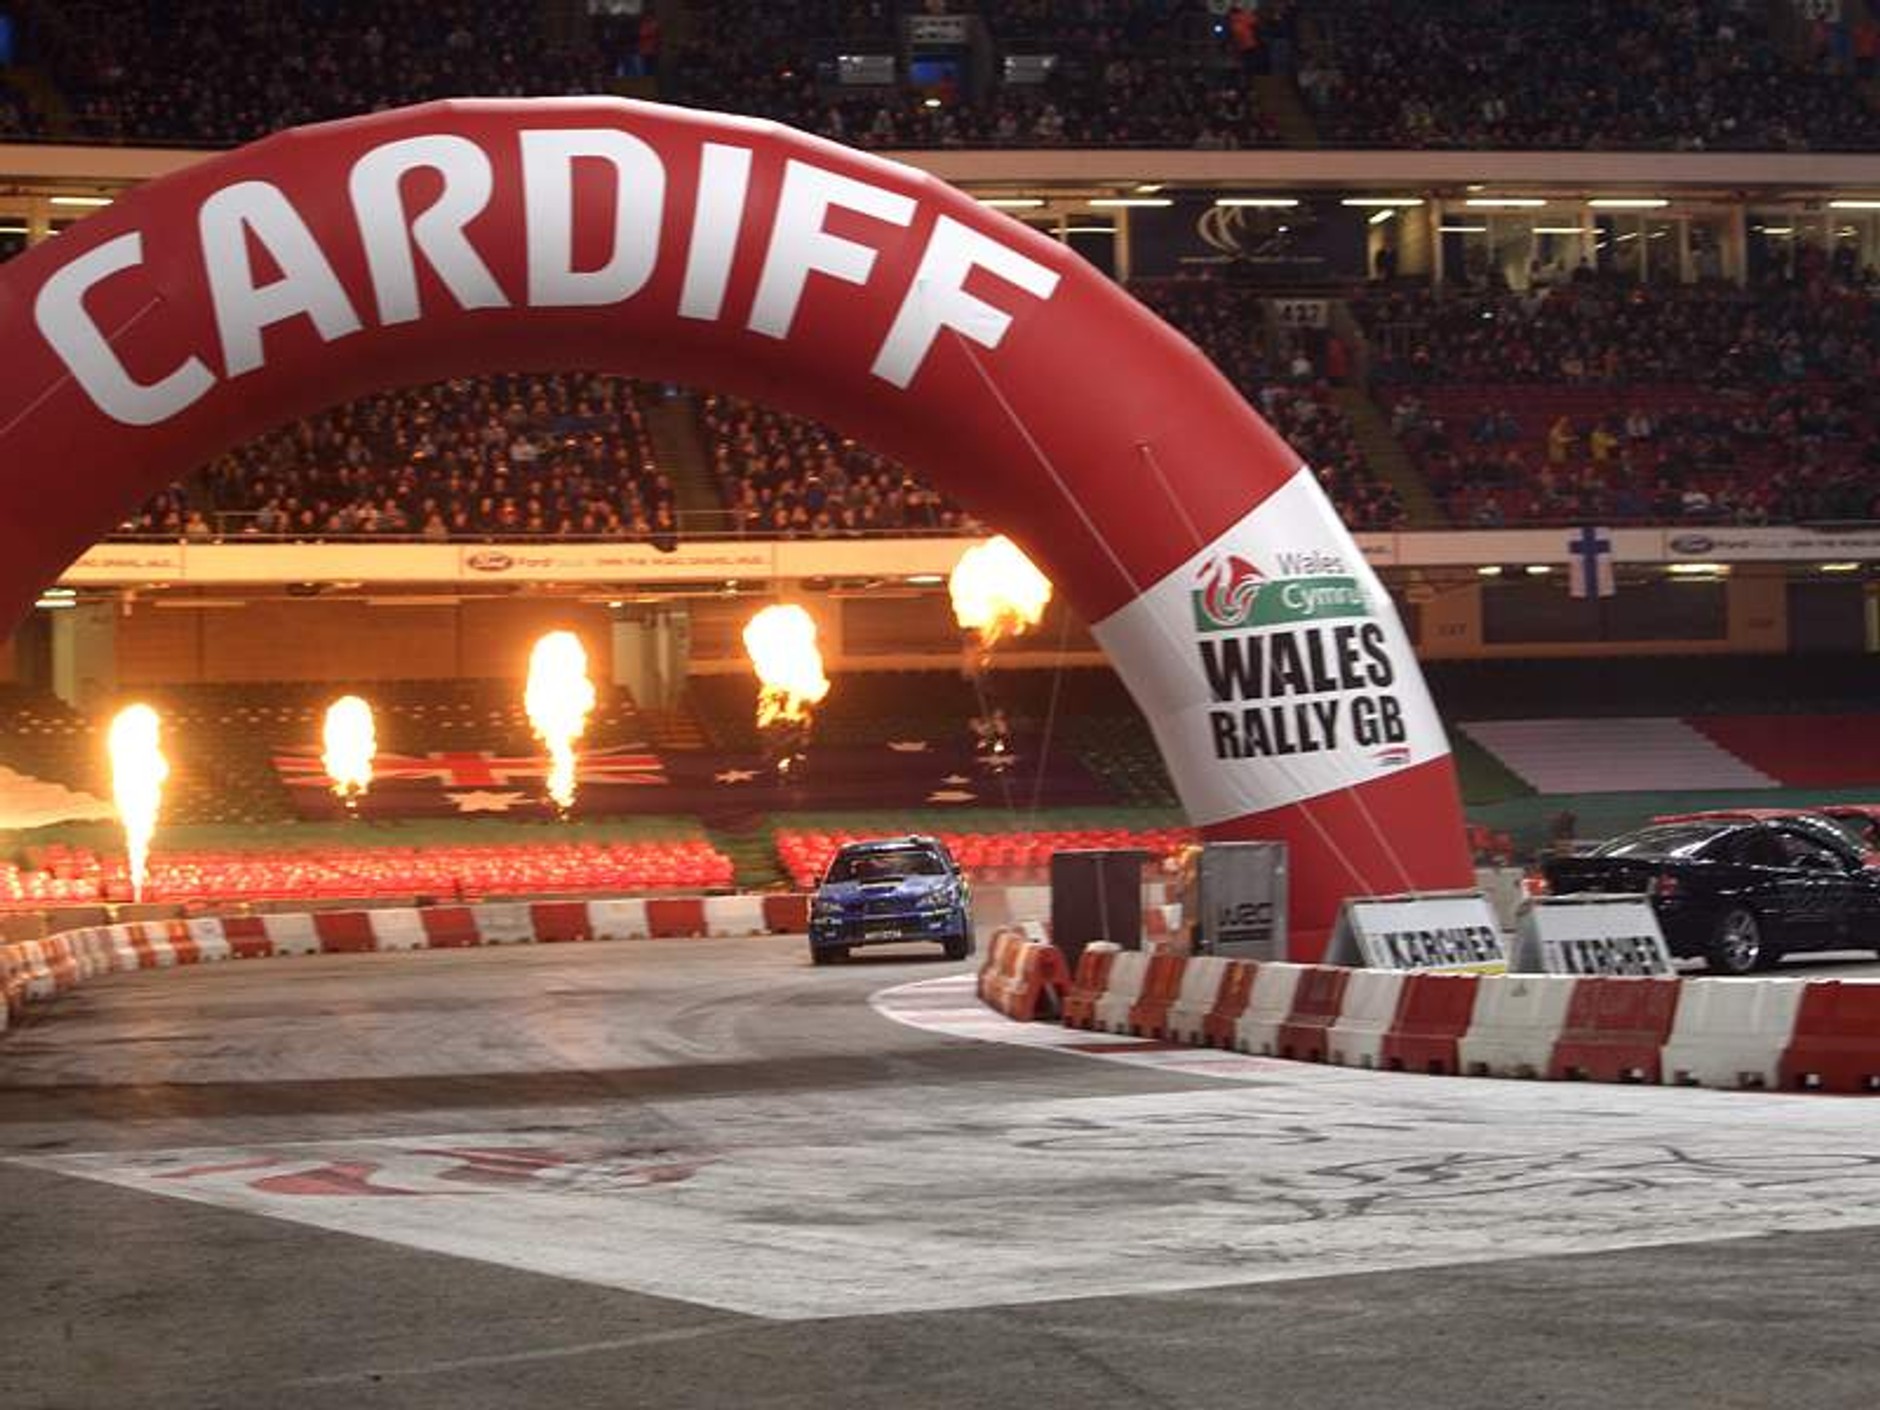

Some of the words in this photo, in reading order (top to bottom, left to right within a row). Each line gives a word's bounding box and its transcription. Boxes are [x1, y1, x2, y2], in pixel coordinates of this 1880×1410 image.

[34, 127, 1060, 426] CARDIFF
[1276, 550, 1346, 575] Wales
[1197, 622, 1394, 702] WALES
[1208, 698, 1340, 760] RALLY
[1351, 695, 1407, 746] GB
